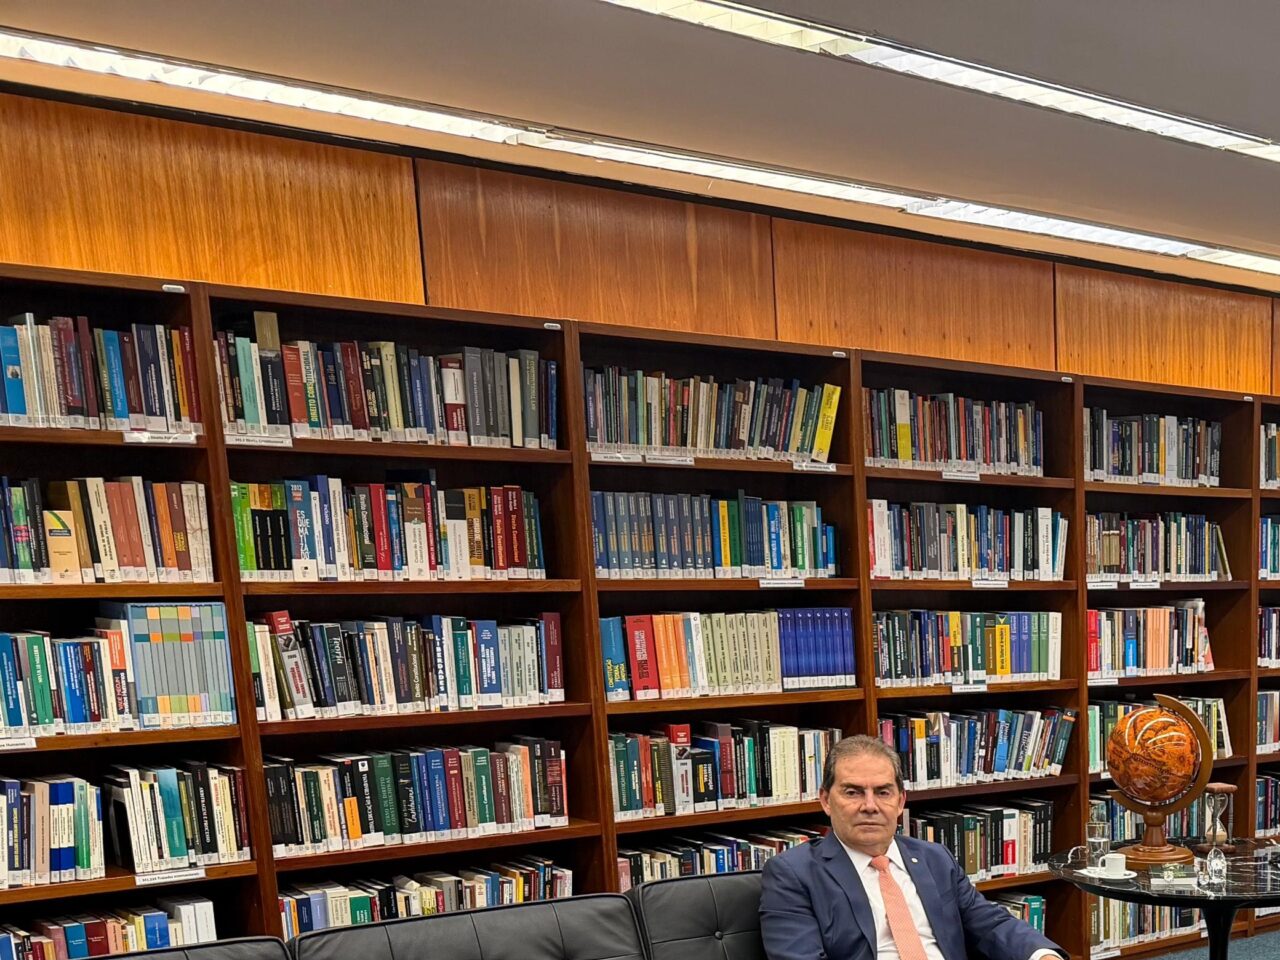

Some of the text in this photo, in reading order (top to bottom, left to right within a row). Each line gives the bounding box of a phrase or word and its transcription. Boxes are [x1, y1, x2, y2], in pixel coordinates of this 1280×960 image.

[302, 350, 315, 398] CONSTITUCIONAL
[359, 494, 370, 544] Direito Constitucional
[332, 637, 344, 664] Teoria
[411, 654, 421, 697] Direito Constitucional
[386, 777, 396, 825] CONSTITUCIONAL
